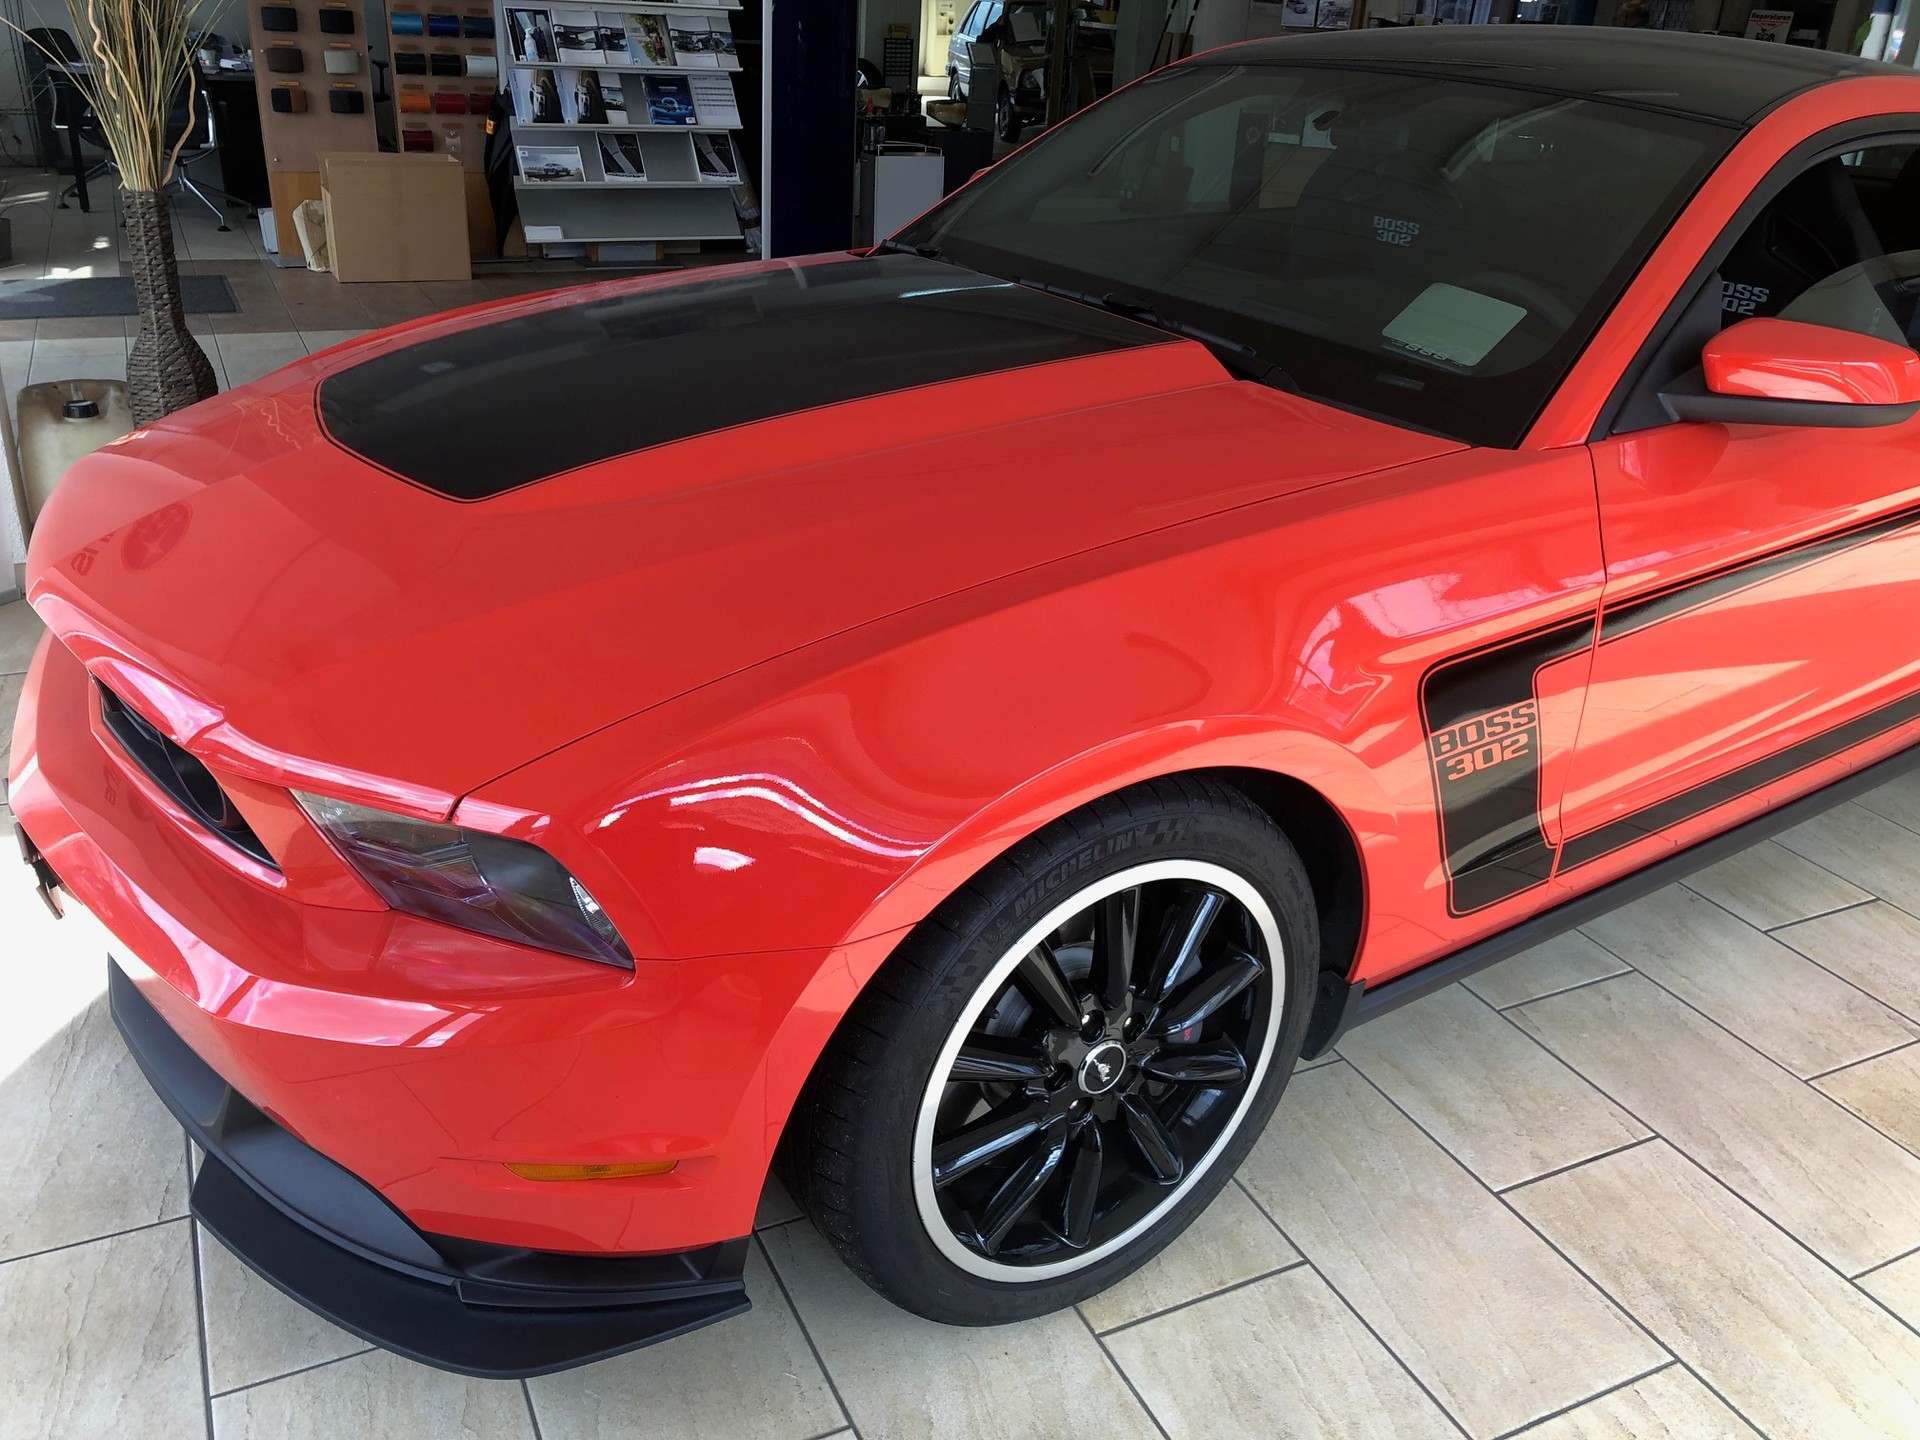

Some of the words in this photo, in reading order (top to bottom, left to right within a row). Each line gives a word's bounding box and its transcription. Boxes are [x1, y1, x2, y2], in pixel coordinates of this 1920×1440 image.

[1373, 215, 1420, 235] BOSS
[1376, 229, 1411, 247] 302
[1721, 280, 1770, 302] OSS
[1721, 296, 1756, 316] 02
[1433, 703, 1536, 757] BOSS
[1446, 733, 1529, 781] 302
[1013, 828, 1135, 916] MICHELIN
